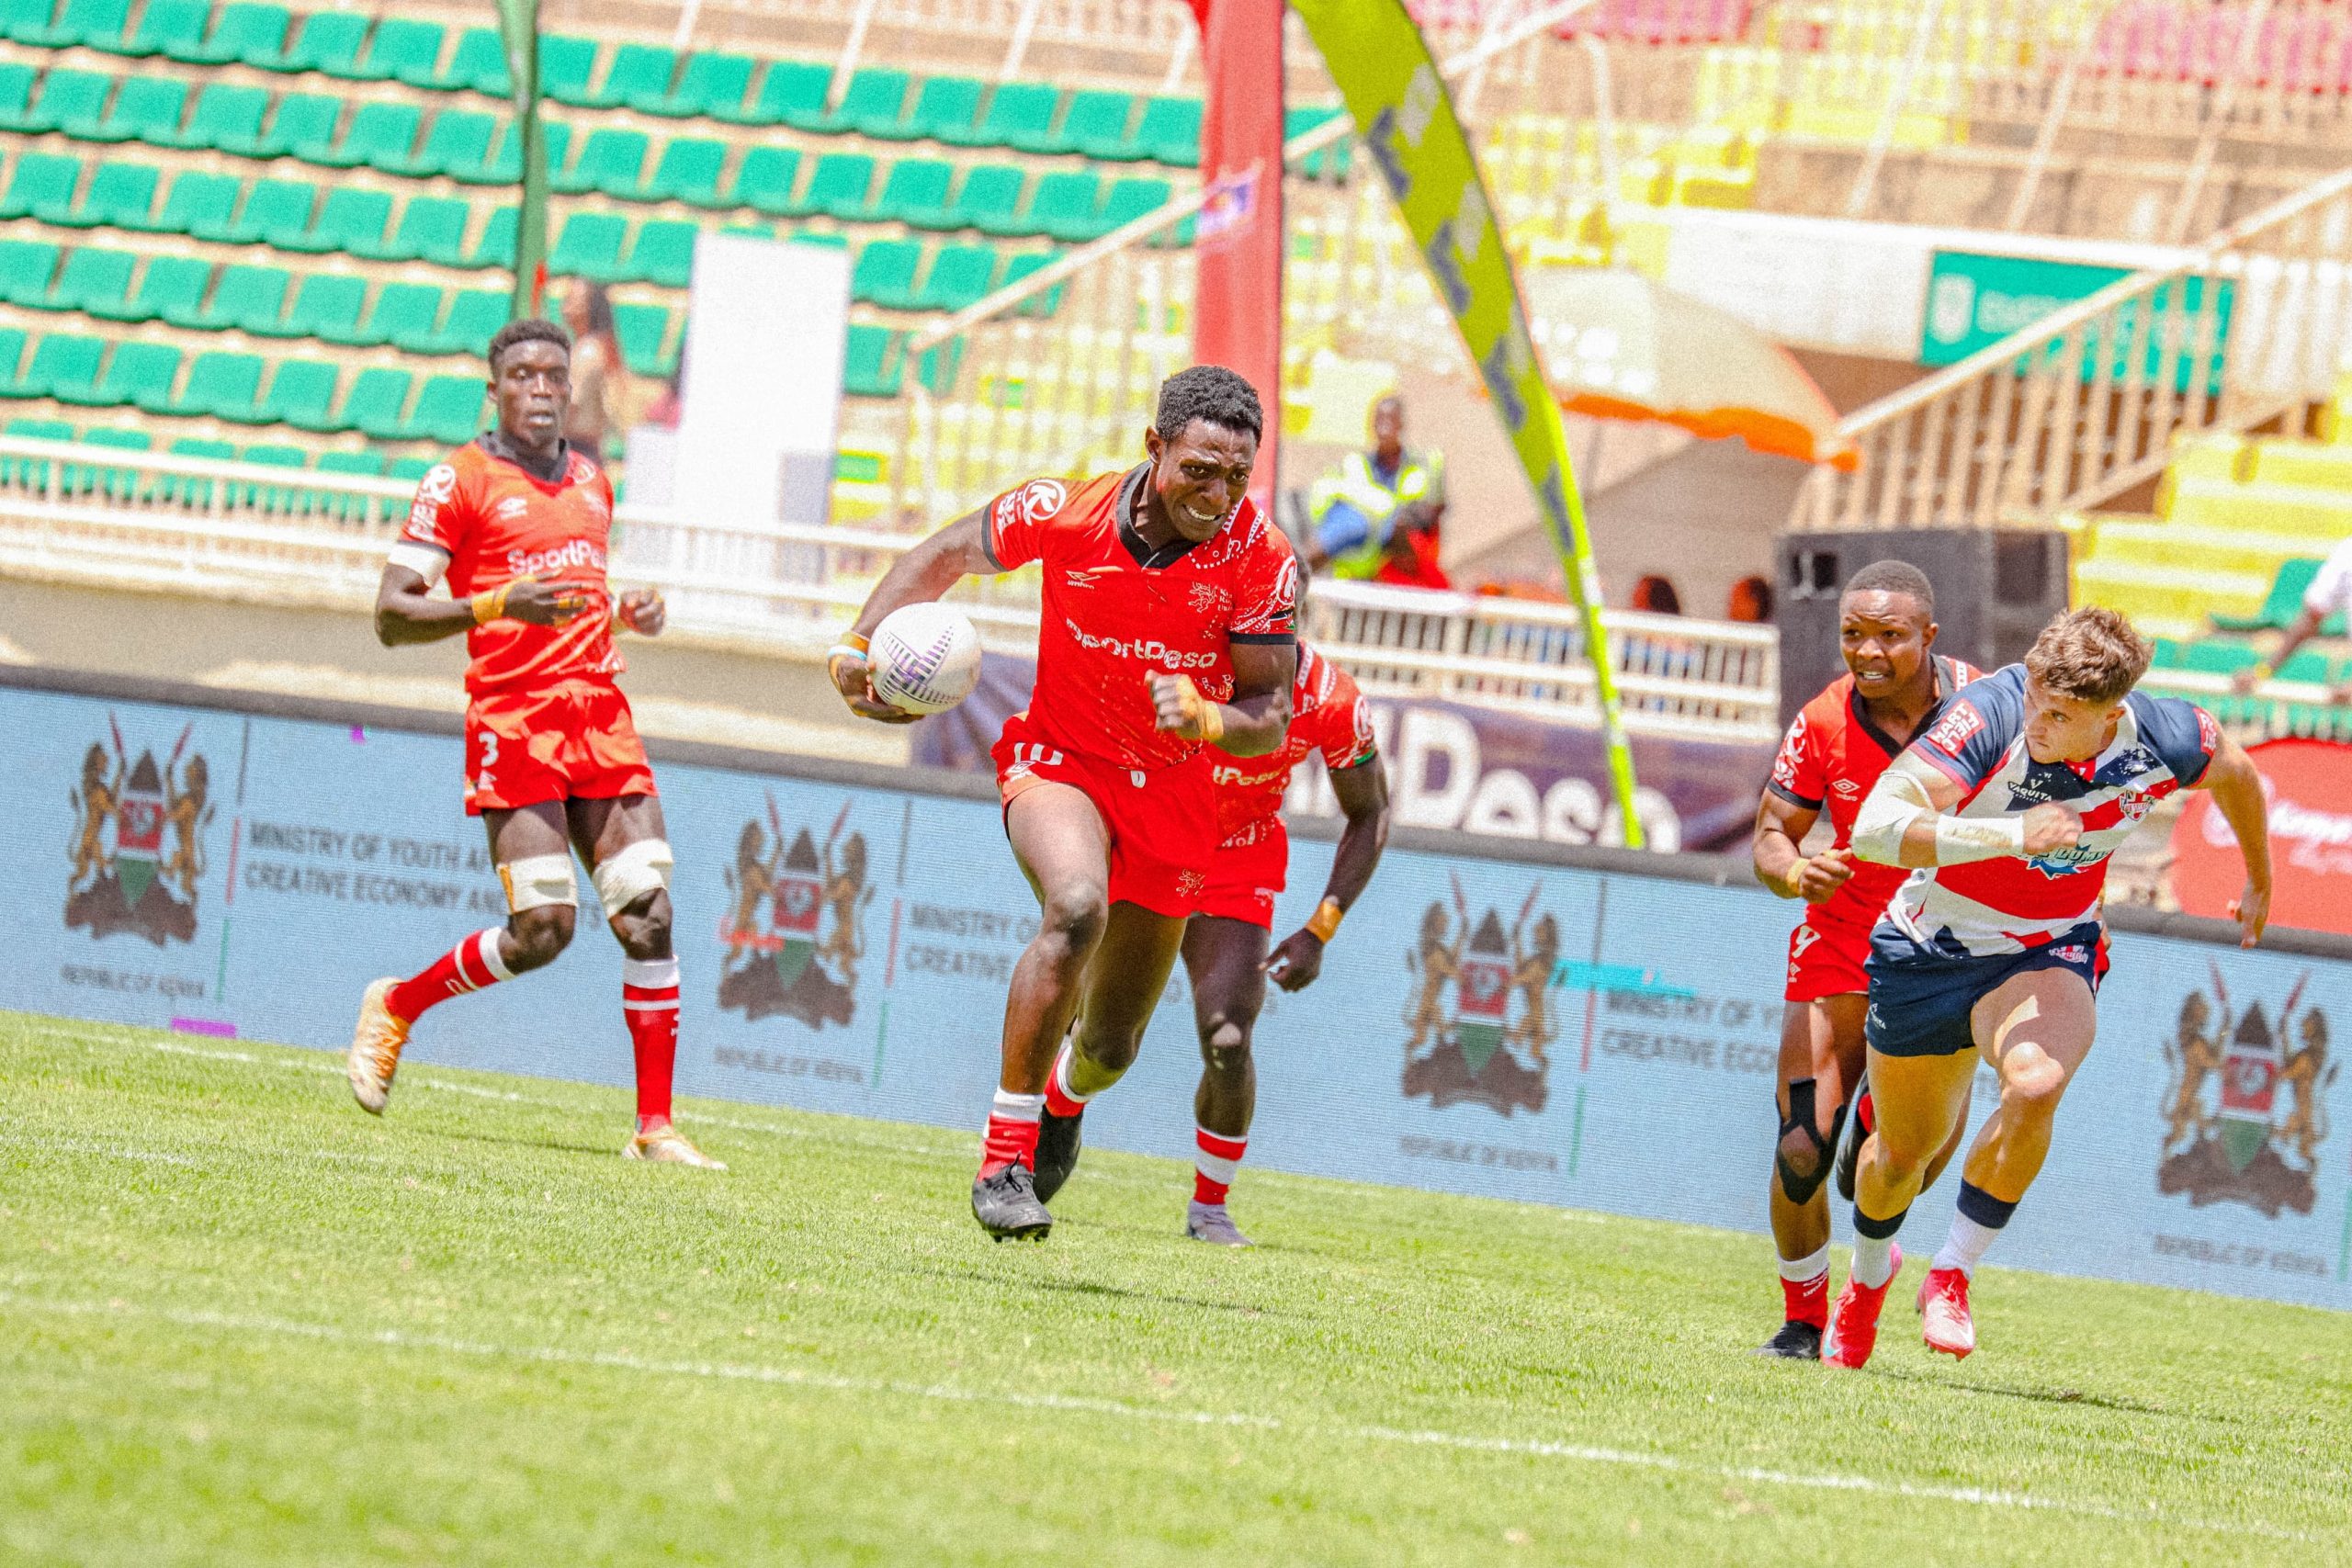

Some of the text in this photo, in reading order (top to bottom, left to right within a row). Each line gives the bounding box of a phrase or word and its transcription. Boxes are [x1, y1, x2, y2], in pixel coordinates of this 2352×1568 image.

[479, 731, 500, 767] 3
[2009, 782, 2052, 802] VAQUITA
[250, 820, 345, 856] MINISTRY
[351, 833, 379, 861] OF
[389, 839, 459, 870] YOUTH
[244, 861, 348, 900] CREATIVE
[354, 874, 460, 910] ECONOMY
[911, 903, 1011, 941] MINISTRY
[1719, 998, 1753, 1028] OF
[1601, 1027, 1717, 1071] CREATIVE
